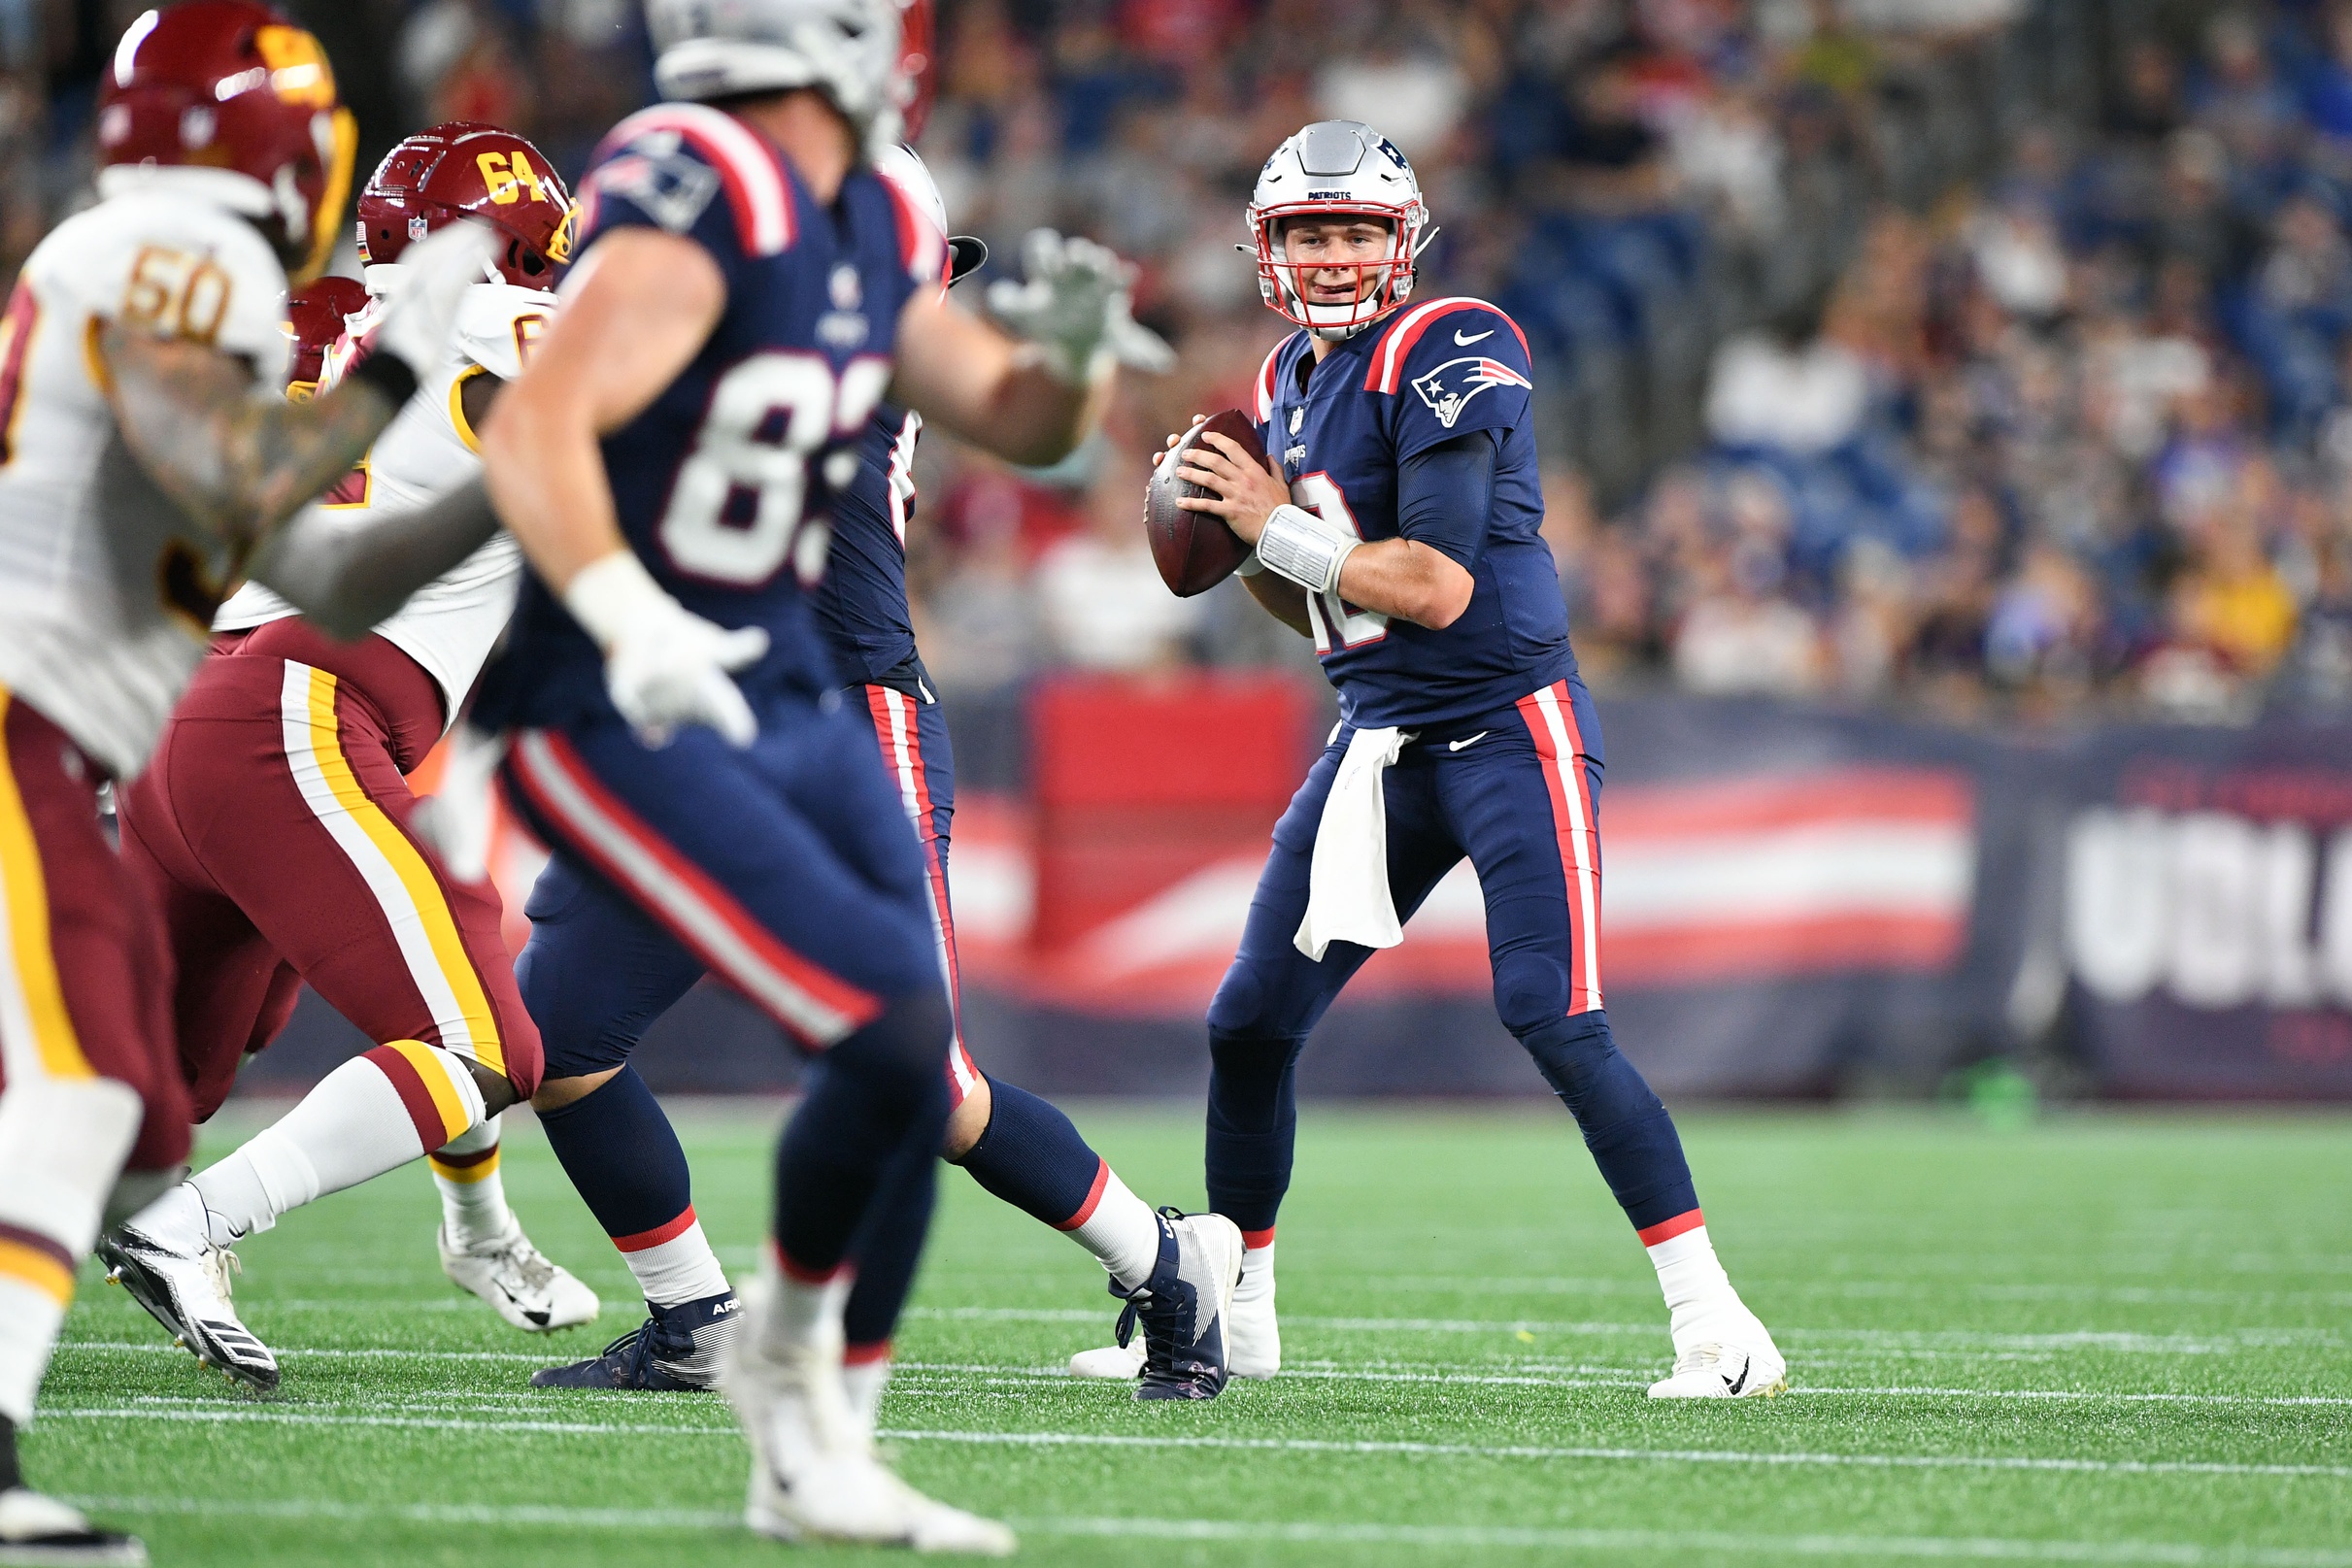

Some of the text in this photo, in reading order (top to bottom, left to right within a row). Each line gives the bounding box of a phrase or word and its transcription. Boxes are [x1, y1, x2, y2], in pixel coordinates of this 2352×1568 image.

[476, 151, 548, 204] 64
[1308, 191, 1352, 201] PATRIOTS
[122, 245, 233, 344] 50
